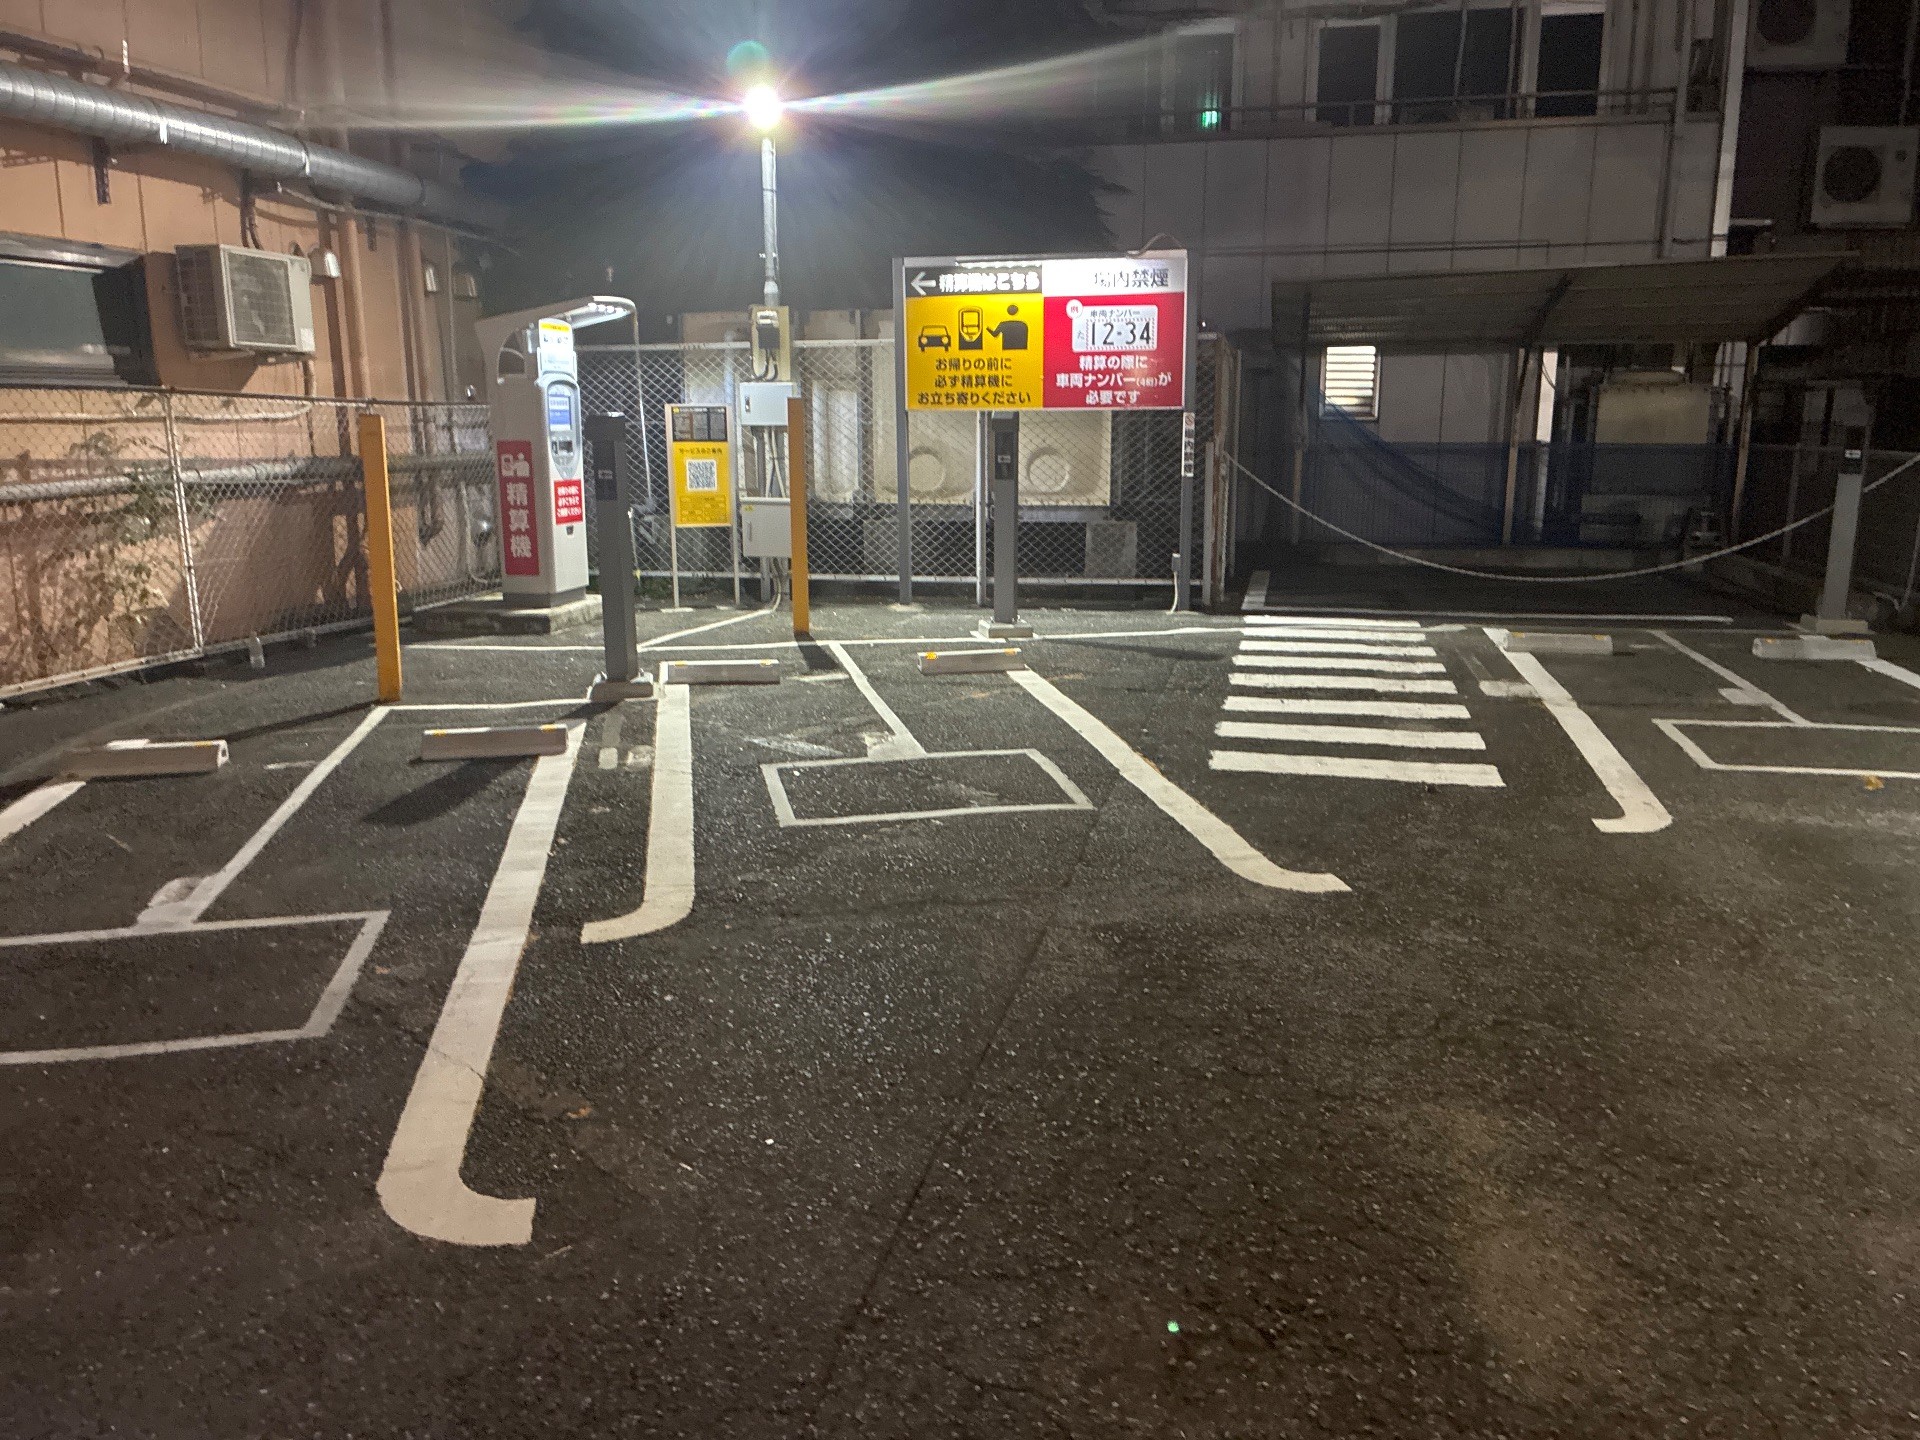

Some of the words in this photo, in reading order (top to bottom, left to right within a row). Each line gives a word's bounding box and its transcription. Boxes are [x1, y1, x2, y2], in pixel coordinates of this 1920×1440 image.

[935, 357, 1012, 371] お帰りの前に
[1079, 355, 1148, 371] 精算の際に
[934, 374, 1013, 388] 必ず精算機に
[917, 391, 1031, 405] お立ち寄りください
[1085, 389, 1140, 405] 必要です
[506, 482, 532, 558] 精算機
